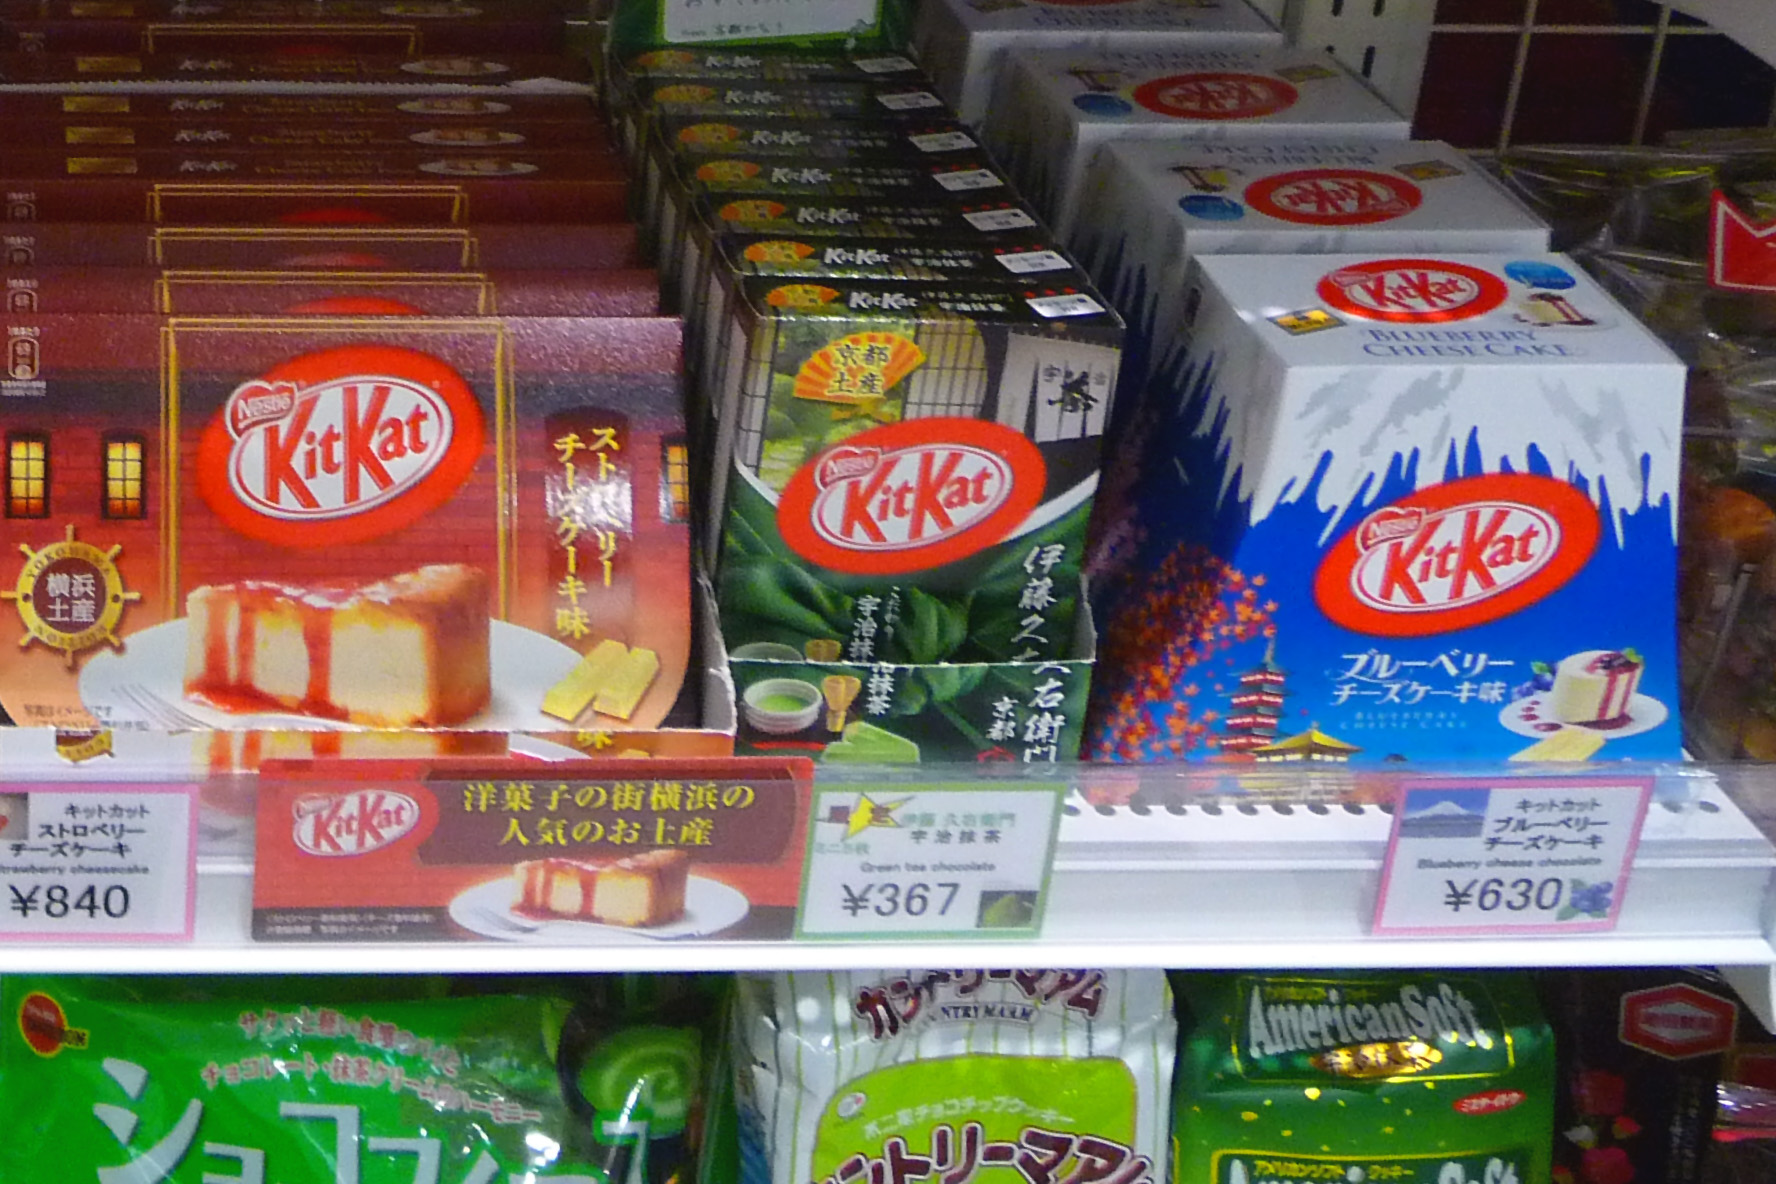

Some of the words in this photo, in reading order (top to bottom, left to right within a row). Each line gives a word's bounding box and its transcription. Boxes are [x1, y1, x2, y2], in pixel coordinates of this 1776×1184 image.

[1362, 270, 1470, 310] KitKat
[1366, 328, 1537, 343] BLUEBERRY
[835, 343, 891, 367] 京都
[824, 371, 885, 396] 土産
[262, 385, 430, 509] KitKat
[838, 450, 996, 544] KitKat
[1378, 508, 1541, 606] KitKat
[46, 572, 96, 598] 横浜
[46, 597, 96, 623] 土産
[1331, 648, 1516, 682] ブルーベリー
[1328, 681, 1508, 706] チーズケーキ味
[64, 803, 151, 819] キットカット
[463, 783, 755, 813] 洋菓子の街横浜の
[1516, 797, 1603, 812] キットカット
[38, 823, 146, 839] ストロベリー
[311, 794, 406, 852] KitKat
[497, 817, 715, 848] 人気のお土産
[1493, 816, 1610, 834] ブルーベリー
[9, 842, 132, 858] チーズケーキ
[1484, 834, 1604, 852] チーズケーキ
[8, 884, 131, 919] ¥840
[841, 882, 962, 918] ¥367
[1443, 877, 1564, 913] ¥630
